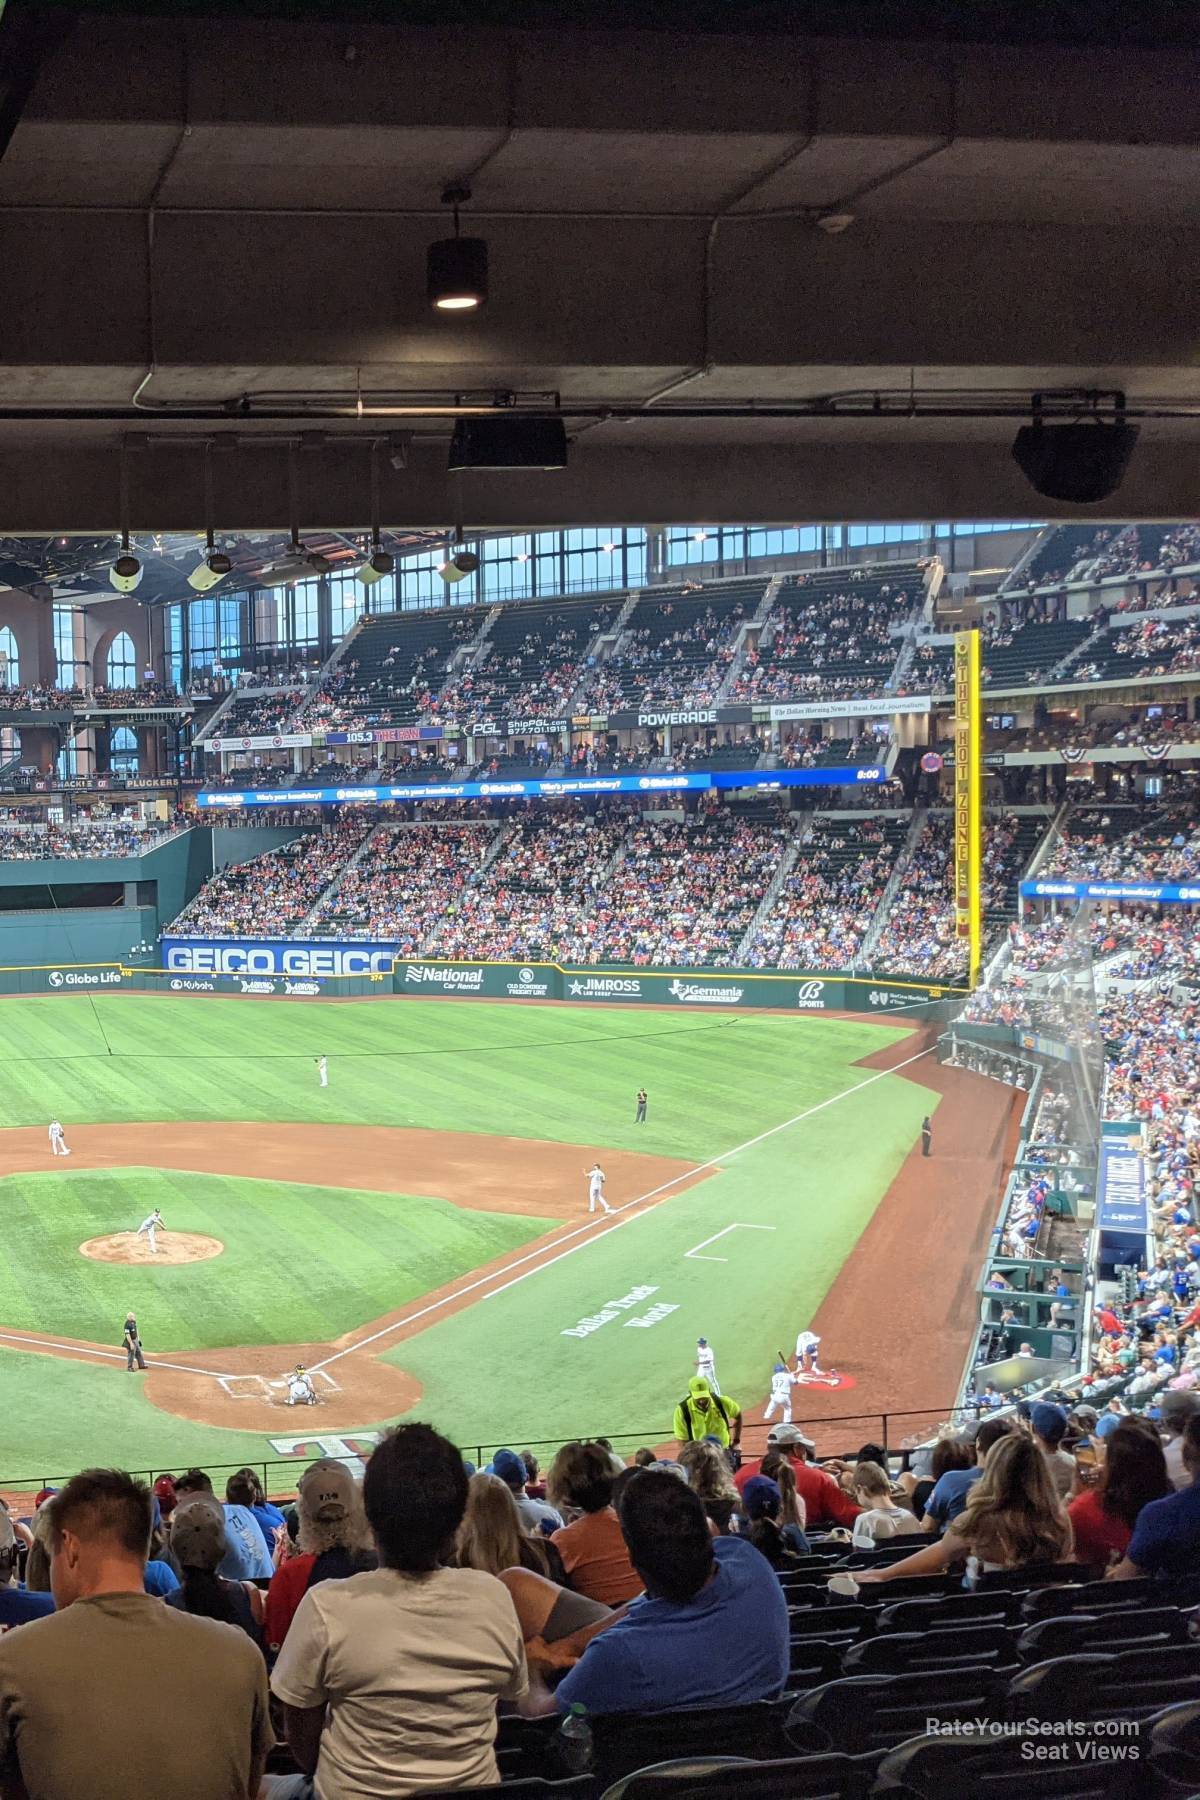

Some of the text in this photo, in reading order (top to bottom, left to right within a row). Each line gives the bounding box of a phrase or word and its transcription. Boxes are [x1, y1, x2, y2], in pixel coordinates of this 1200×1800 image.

[958, 666, 968, 719] THE
[830, 705, 847, 713] News
[638, 710, 717, 726] POWERADE
[473, 722, 501, 733] PGL
[507, 719, 567, 729] ShipPGL.com
[507, 725, 567, 735] 877.701.1919
[347, 732, 373, 743] 105.3
[958, 729, 968, 780] HOT
[856, 769, 880, 779] 8:00
[126, 778, 179, 788] PLUCKERS
[539, 782, 561, 791] Who's
[561, 783, 578, 791] your
[390, 787, 408, 796] Who's
[409, 787, 425, 797] your
[958, 794, 969, 861] ZONE
[167, 947, 275, 973] GEICO
[282, 949, 394, 975] GEICO
[65, 971, 122, 985] Globe Life
[183, 981, 214, 991] Kubota
[799, 1000, 825, 1008] SPORTS
[560, 1285, 660, 1338] Dallas Truck
[623, 1302, 681, 1328] World
